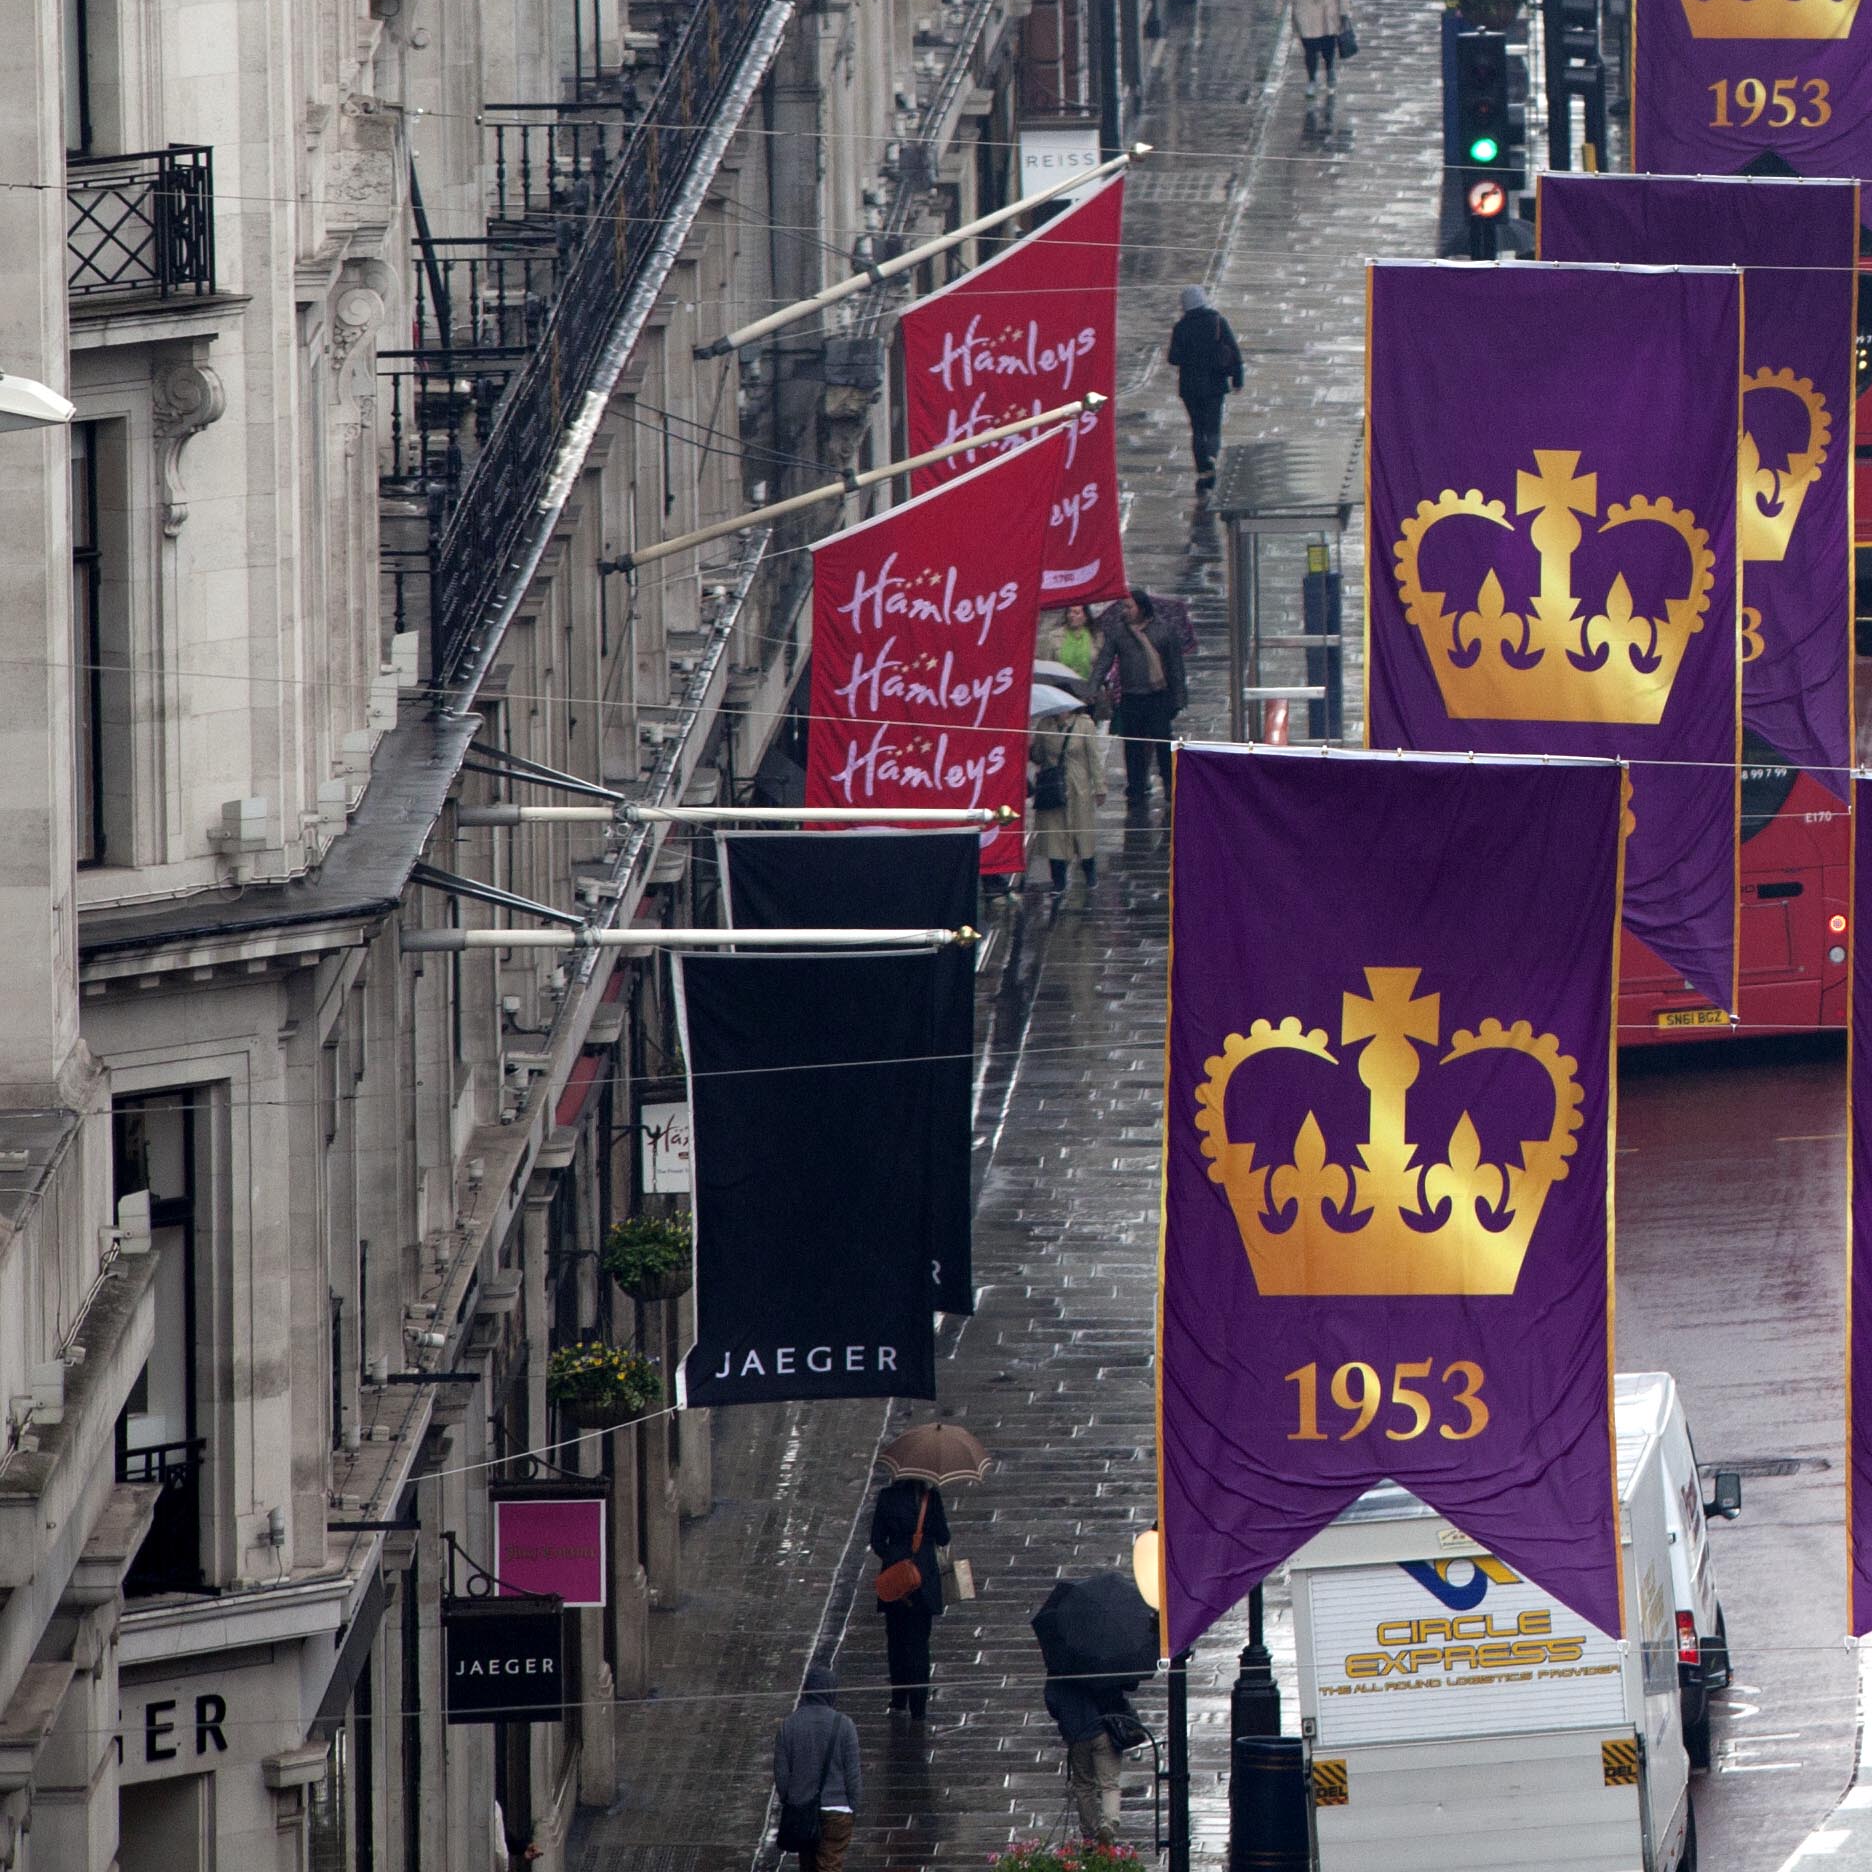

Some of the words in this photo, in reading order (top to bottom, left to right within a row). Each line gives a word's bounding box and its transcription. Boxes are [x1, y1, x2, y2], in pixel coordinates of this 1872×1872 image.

[1711, 79, 1831, 127] 1953
[1024, 152, 1095, 168] REISS
[929, 314, 1095, 391] Hamleys
[837, 552, 1018, 646] Hamleys
[834, 635, 1013, 728] Hamleys
[831, 721, 1005, 809] Hamleys
[1666, 1012, 1695, 1025] SN61
[715, 1346, 898, 1378] JAEGER
[1285, 1359, 1489, 1440] 1953
[1376, 1608, 1552, 1647] CIRCLE
[455, 1658, 554, 1676] JAEGER
[1344, 1635, 1587, 1679] EXPRESS
[1318, 1686, 1352, 1697] THE
[1353, 1681, 1384, 1694] ALL
[1385, 1677, 1442, 1692] ROUND
[1446, 1669, 1533, 1687] LOGISTICS
[1537, 1664, 1621, 1680] PROVIDER
[1604, 1764, 1636, 1778] DEL
[1315, 1785, 1348, 1799] DEL
